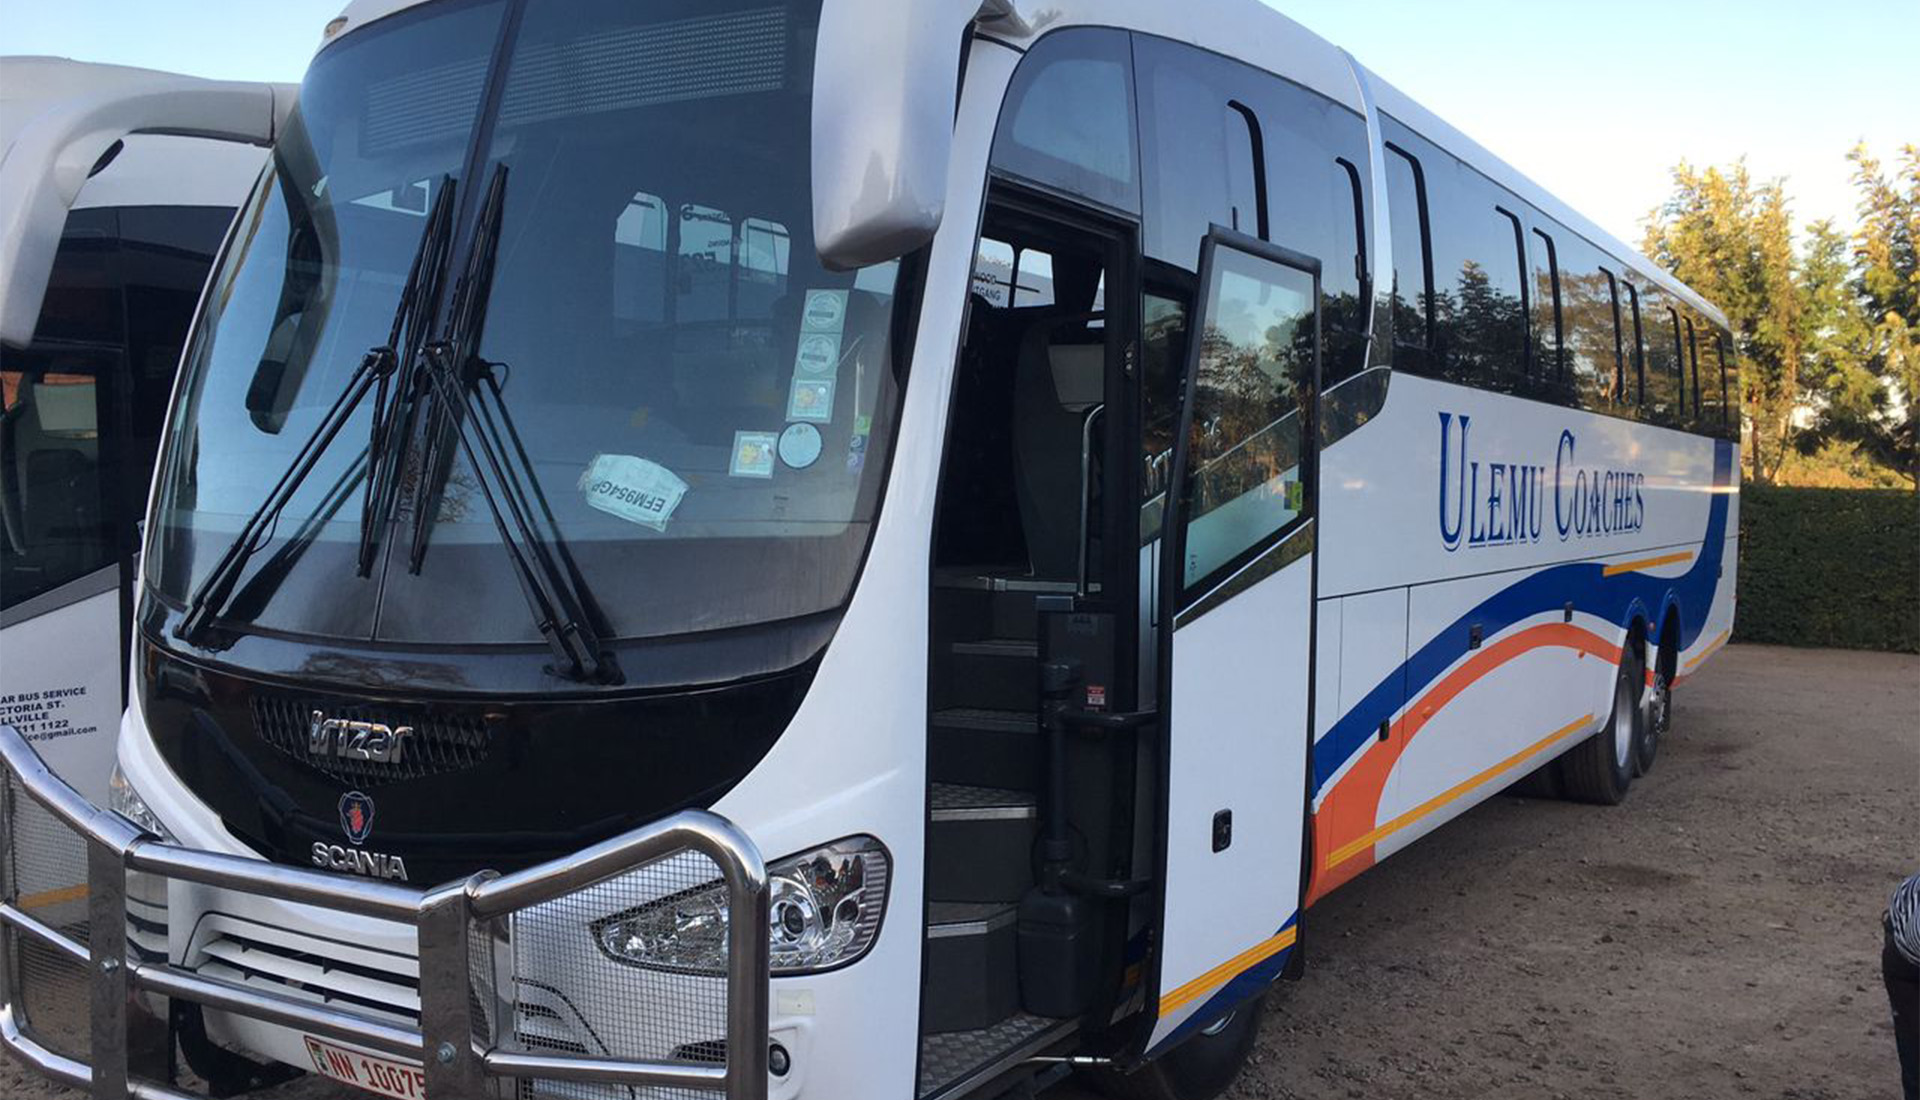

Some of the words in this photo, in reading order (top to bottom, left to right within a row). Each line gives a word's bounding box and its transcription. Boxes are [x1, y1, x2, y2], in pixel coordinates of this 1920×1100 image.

[591, 480, 666, 513] EFM954GP
[18, 692, 40, 702] BUS
[42, 686, 87, 700] SERVICE
[46, 700, 66, 710] ST.
[40, 719, 69, 731] 1122
[311, 841, 408, 881] SCANIA
